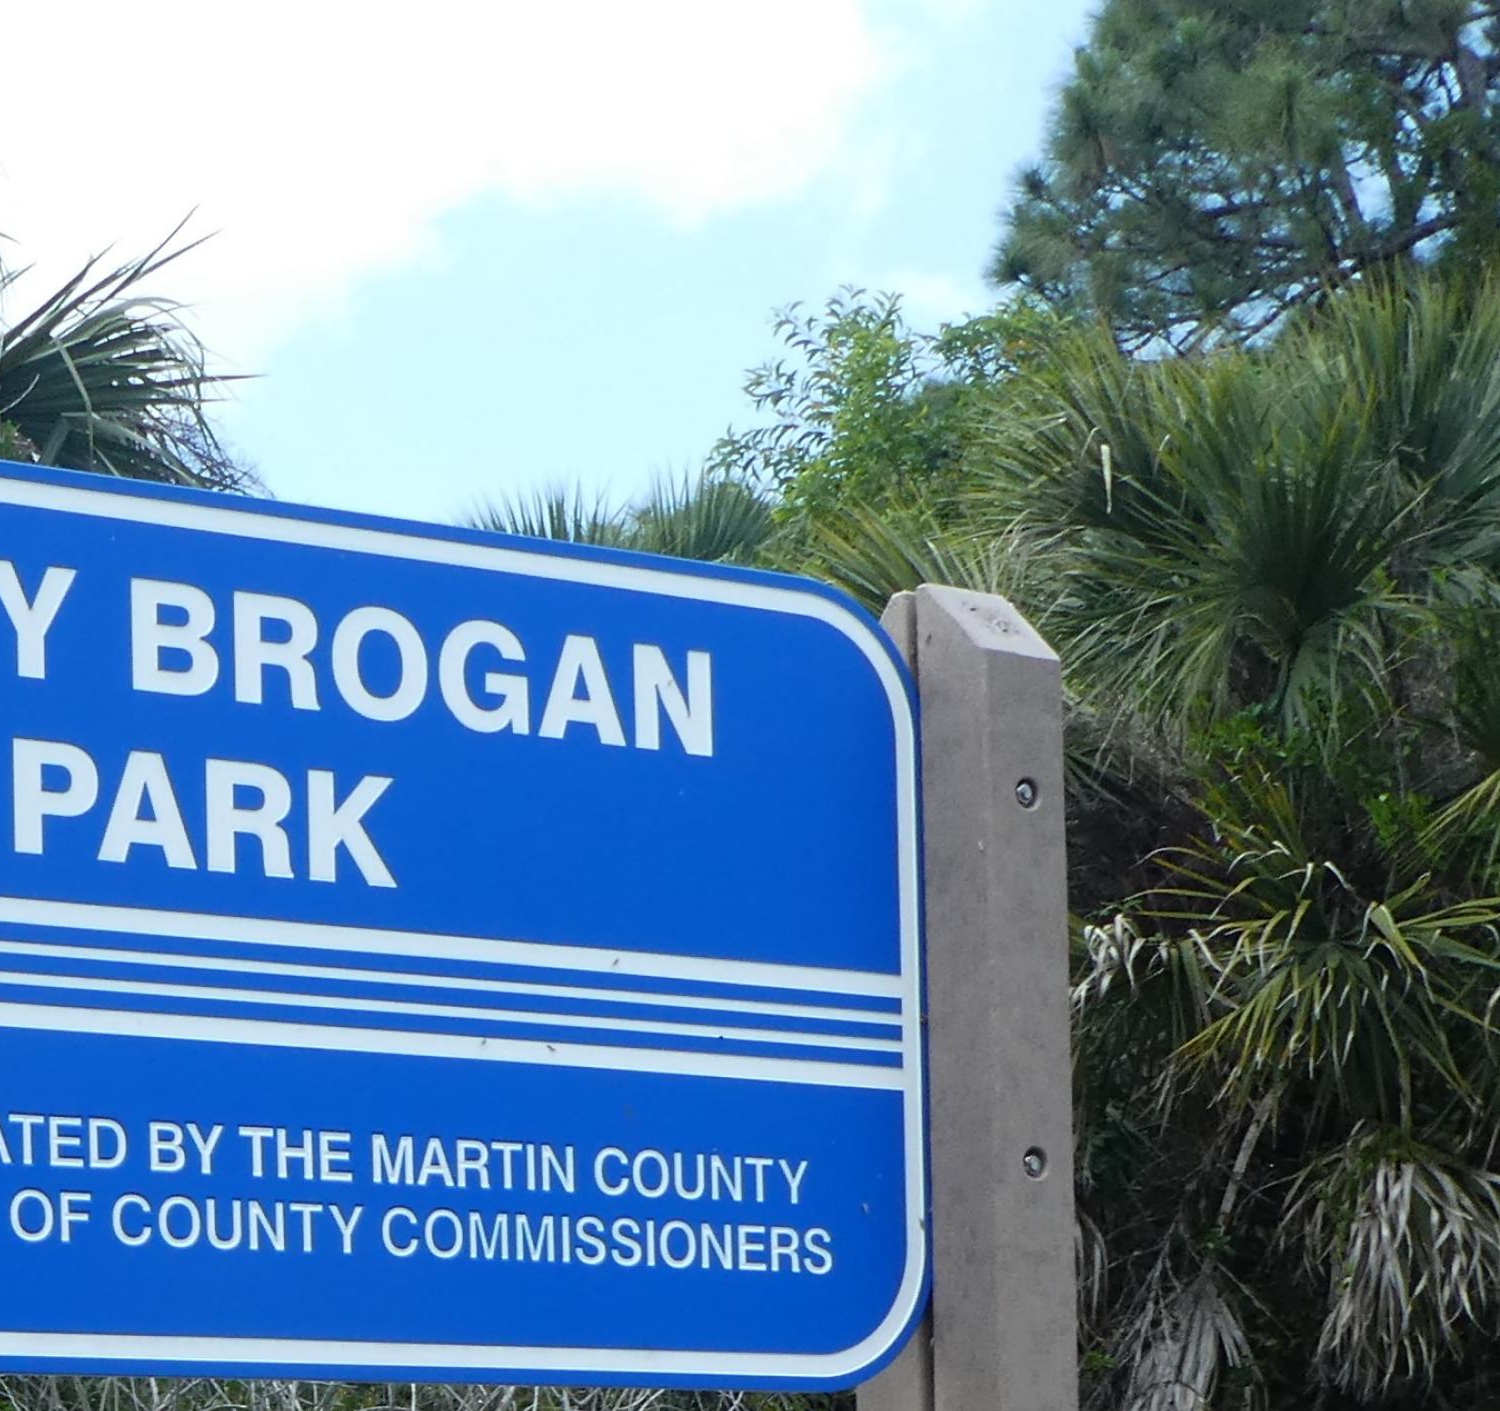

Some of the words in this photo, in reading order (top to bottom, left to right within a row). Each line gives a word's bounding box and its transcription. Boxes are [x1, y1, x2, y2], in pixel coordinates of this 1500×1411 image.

[130, 578, 714, 758] BROGAN
[13, 738, 398, 889] PARK
[149, 1122, 223, 1174] BY
[239, 1126, 353, 1182] THE
[372, 1134, 575, 1193] MARTIN
[594, 1147, 808, 1204] COUNTY
[10, 1189, 91, 1242] OF
[112, 1194, 363, 1254] COUNTY
[382, 1207, 833, 1276] COMMISSIONERS
